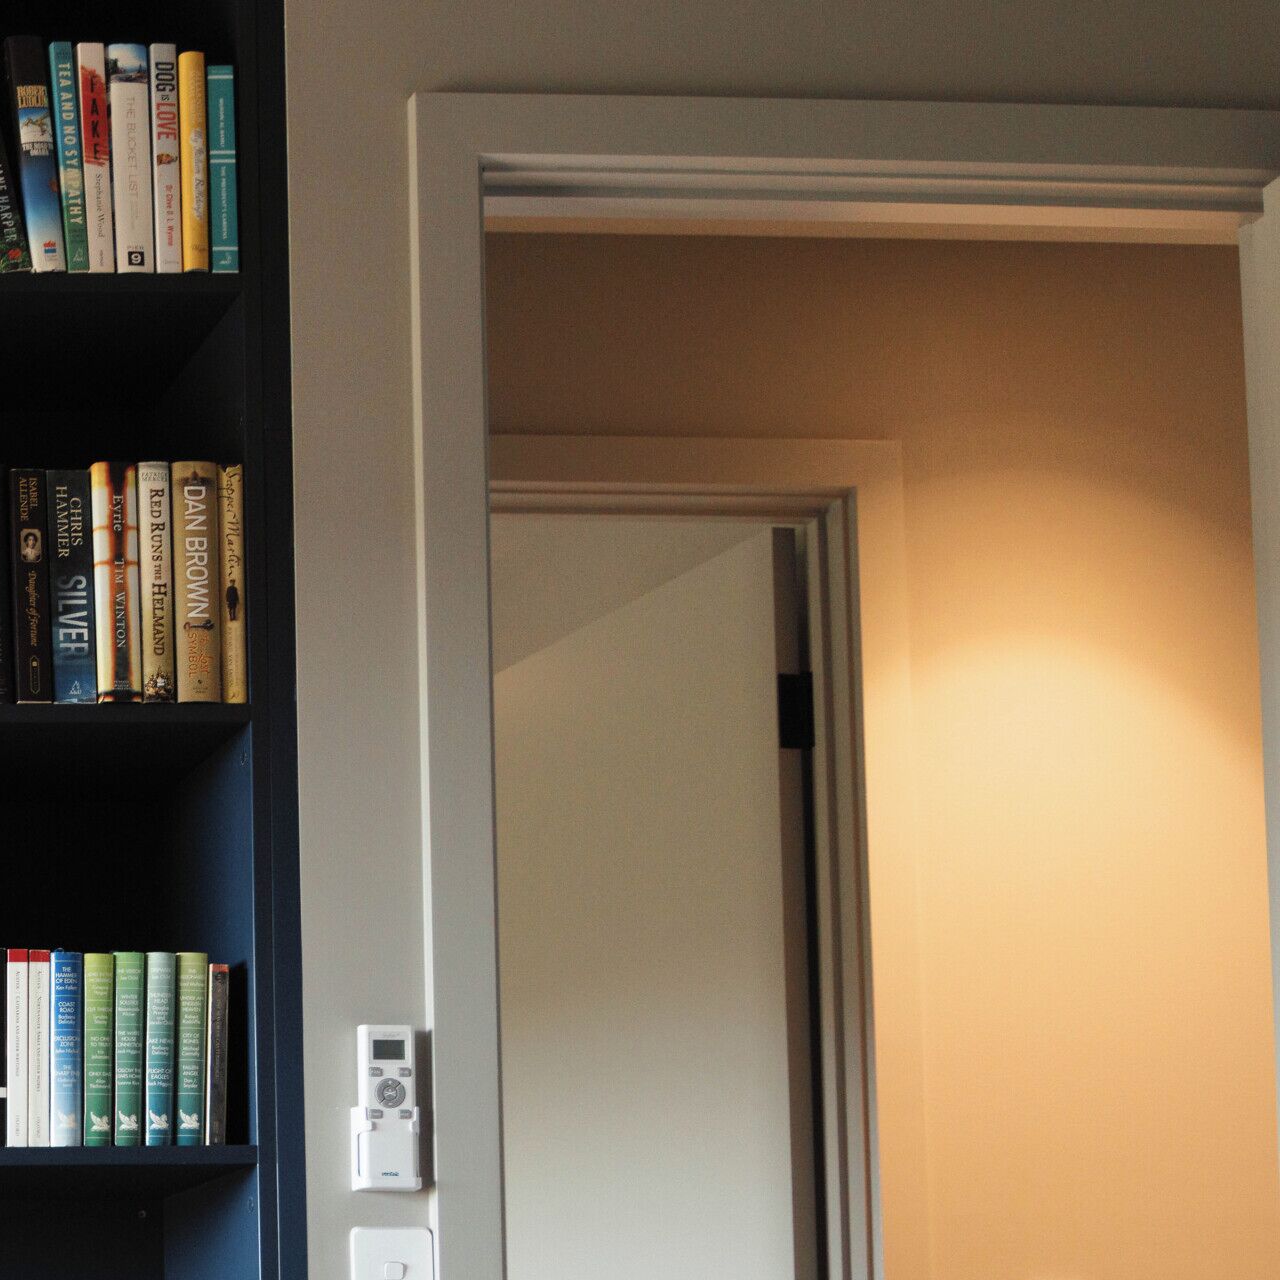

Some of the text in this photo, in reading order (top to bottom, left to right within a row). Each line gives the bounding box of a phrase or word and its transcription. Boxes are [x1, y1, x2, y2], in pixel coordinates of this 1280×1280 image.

[112, 495, 123, 532] Eyrie
[183, 486, 209, 618] DAN BROWN
[57, 575, 88, 656] SILVER
[114, 561, 125, 648] TIM WINTON
[149, 488, 167, 656] RED RUNS THE HELMAND
